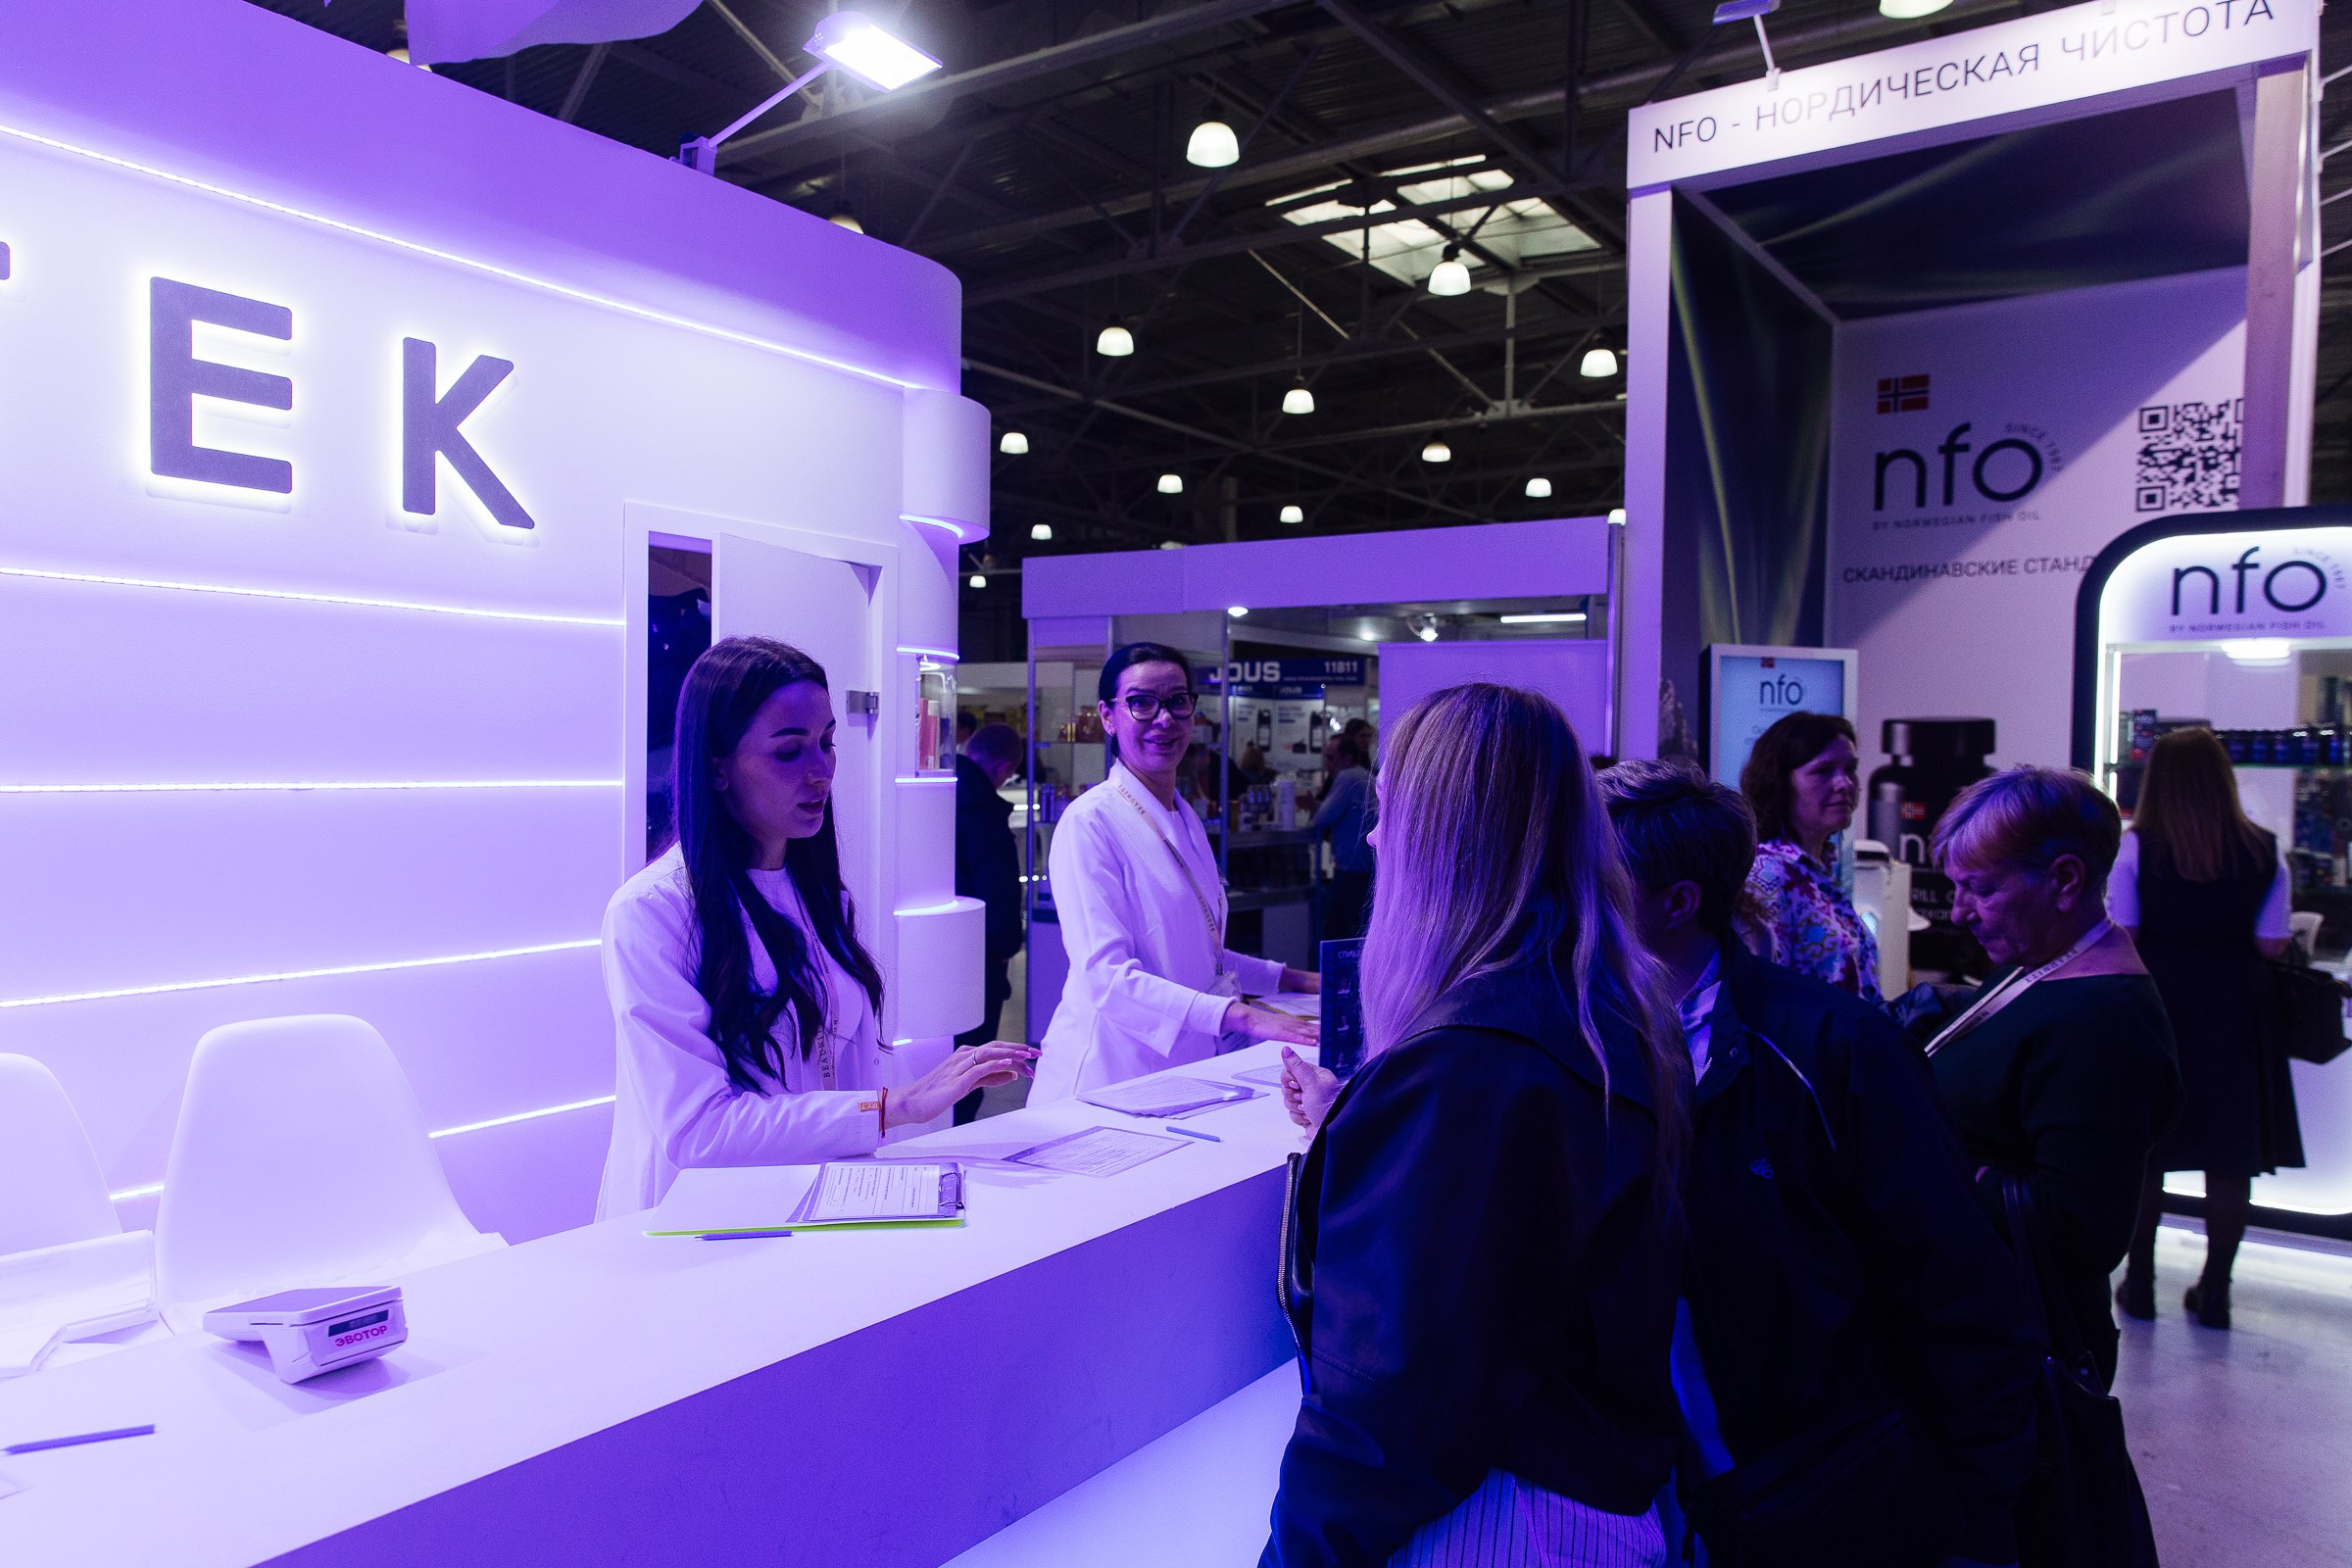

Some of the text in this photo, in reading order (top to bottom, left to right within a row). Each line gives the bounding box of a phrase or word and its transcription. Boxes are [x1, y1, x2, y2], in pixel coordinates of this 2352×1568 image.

[1653, 116, 1717, 153] NFO
[1755, 43, 2040, 130] НОРДИЧЕСКАЯ
[2060, 0, 2275, 62] ЧИСТОТА
[0, 240, 535, 531] EK
[1874, 421, 2043, 512] nfo
[1841, 556, 2095, 584] СКАНДИНАВСКИЕ СТАНД
[2171, 546, 2328, 616] nfo
[1759, 673, 1803, 706] nfo
[334, 1325, 388, 1347] ЭВОТОР
